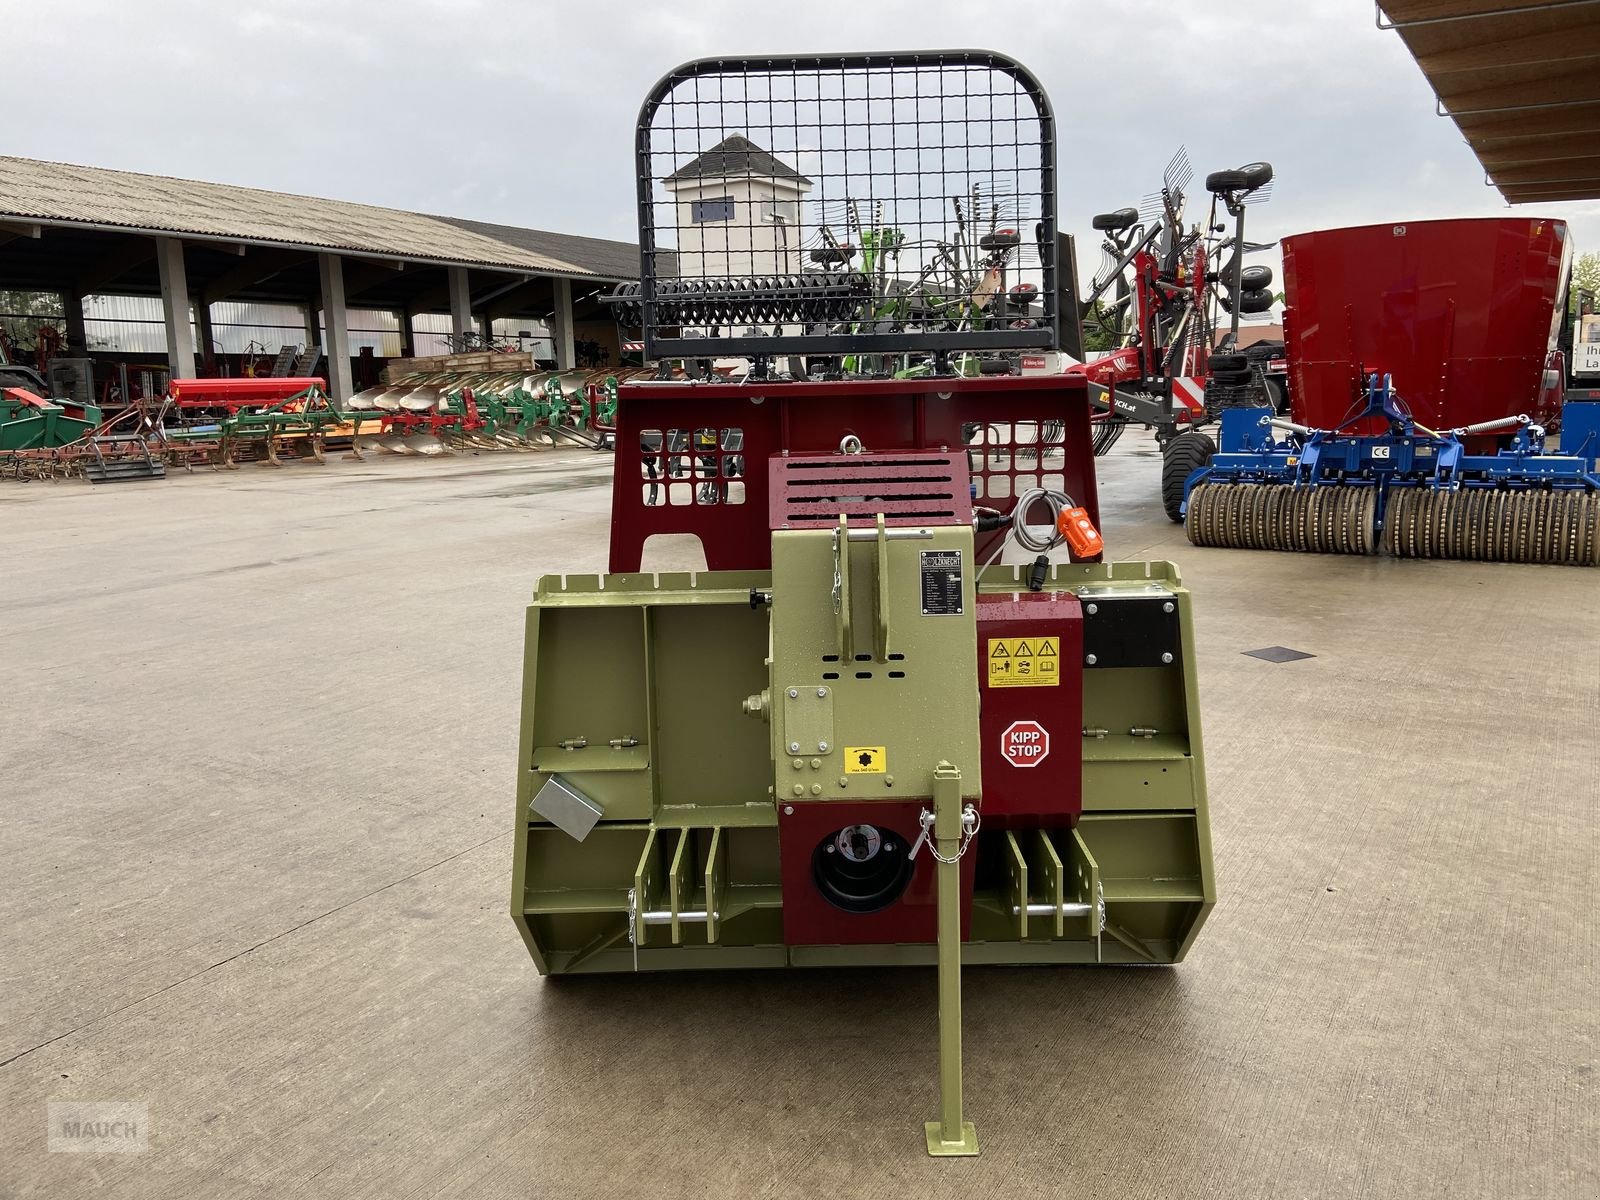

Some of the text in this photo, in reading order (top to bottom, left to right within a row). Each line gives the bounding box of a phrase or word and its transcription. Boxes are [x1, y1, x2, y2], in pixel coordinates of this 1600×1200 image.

[1586, 345, 1600, 355] Ih
[1010, 731, 1041, 744] KIPP
[1008, 744, 1042, 757] STOP
